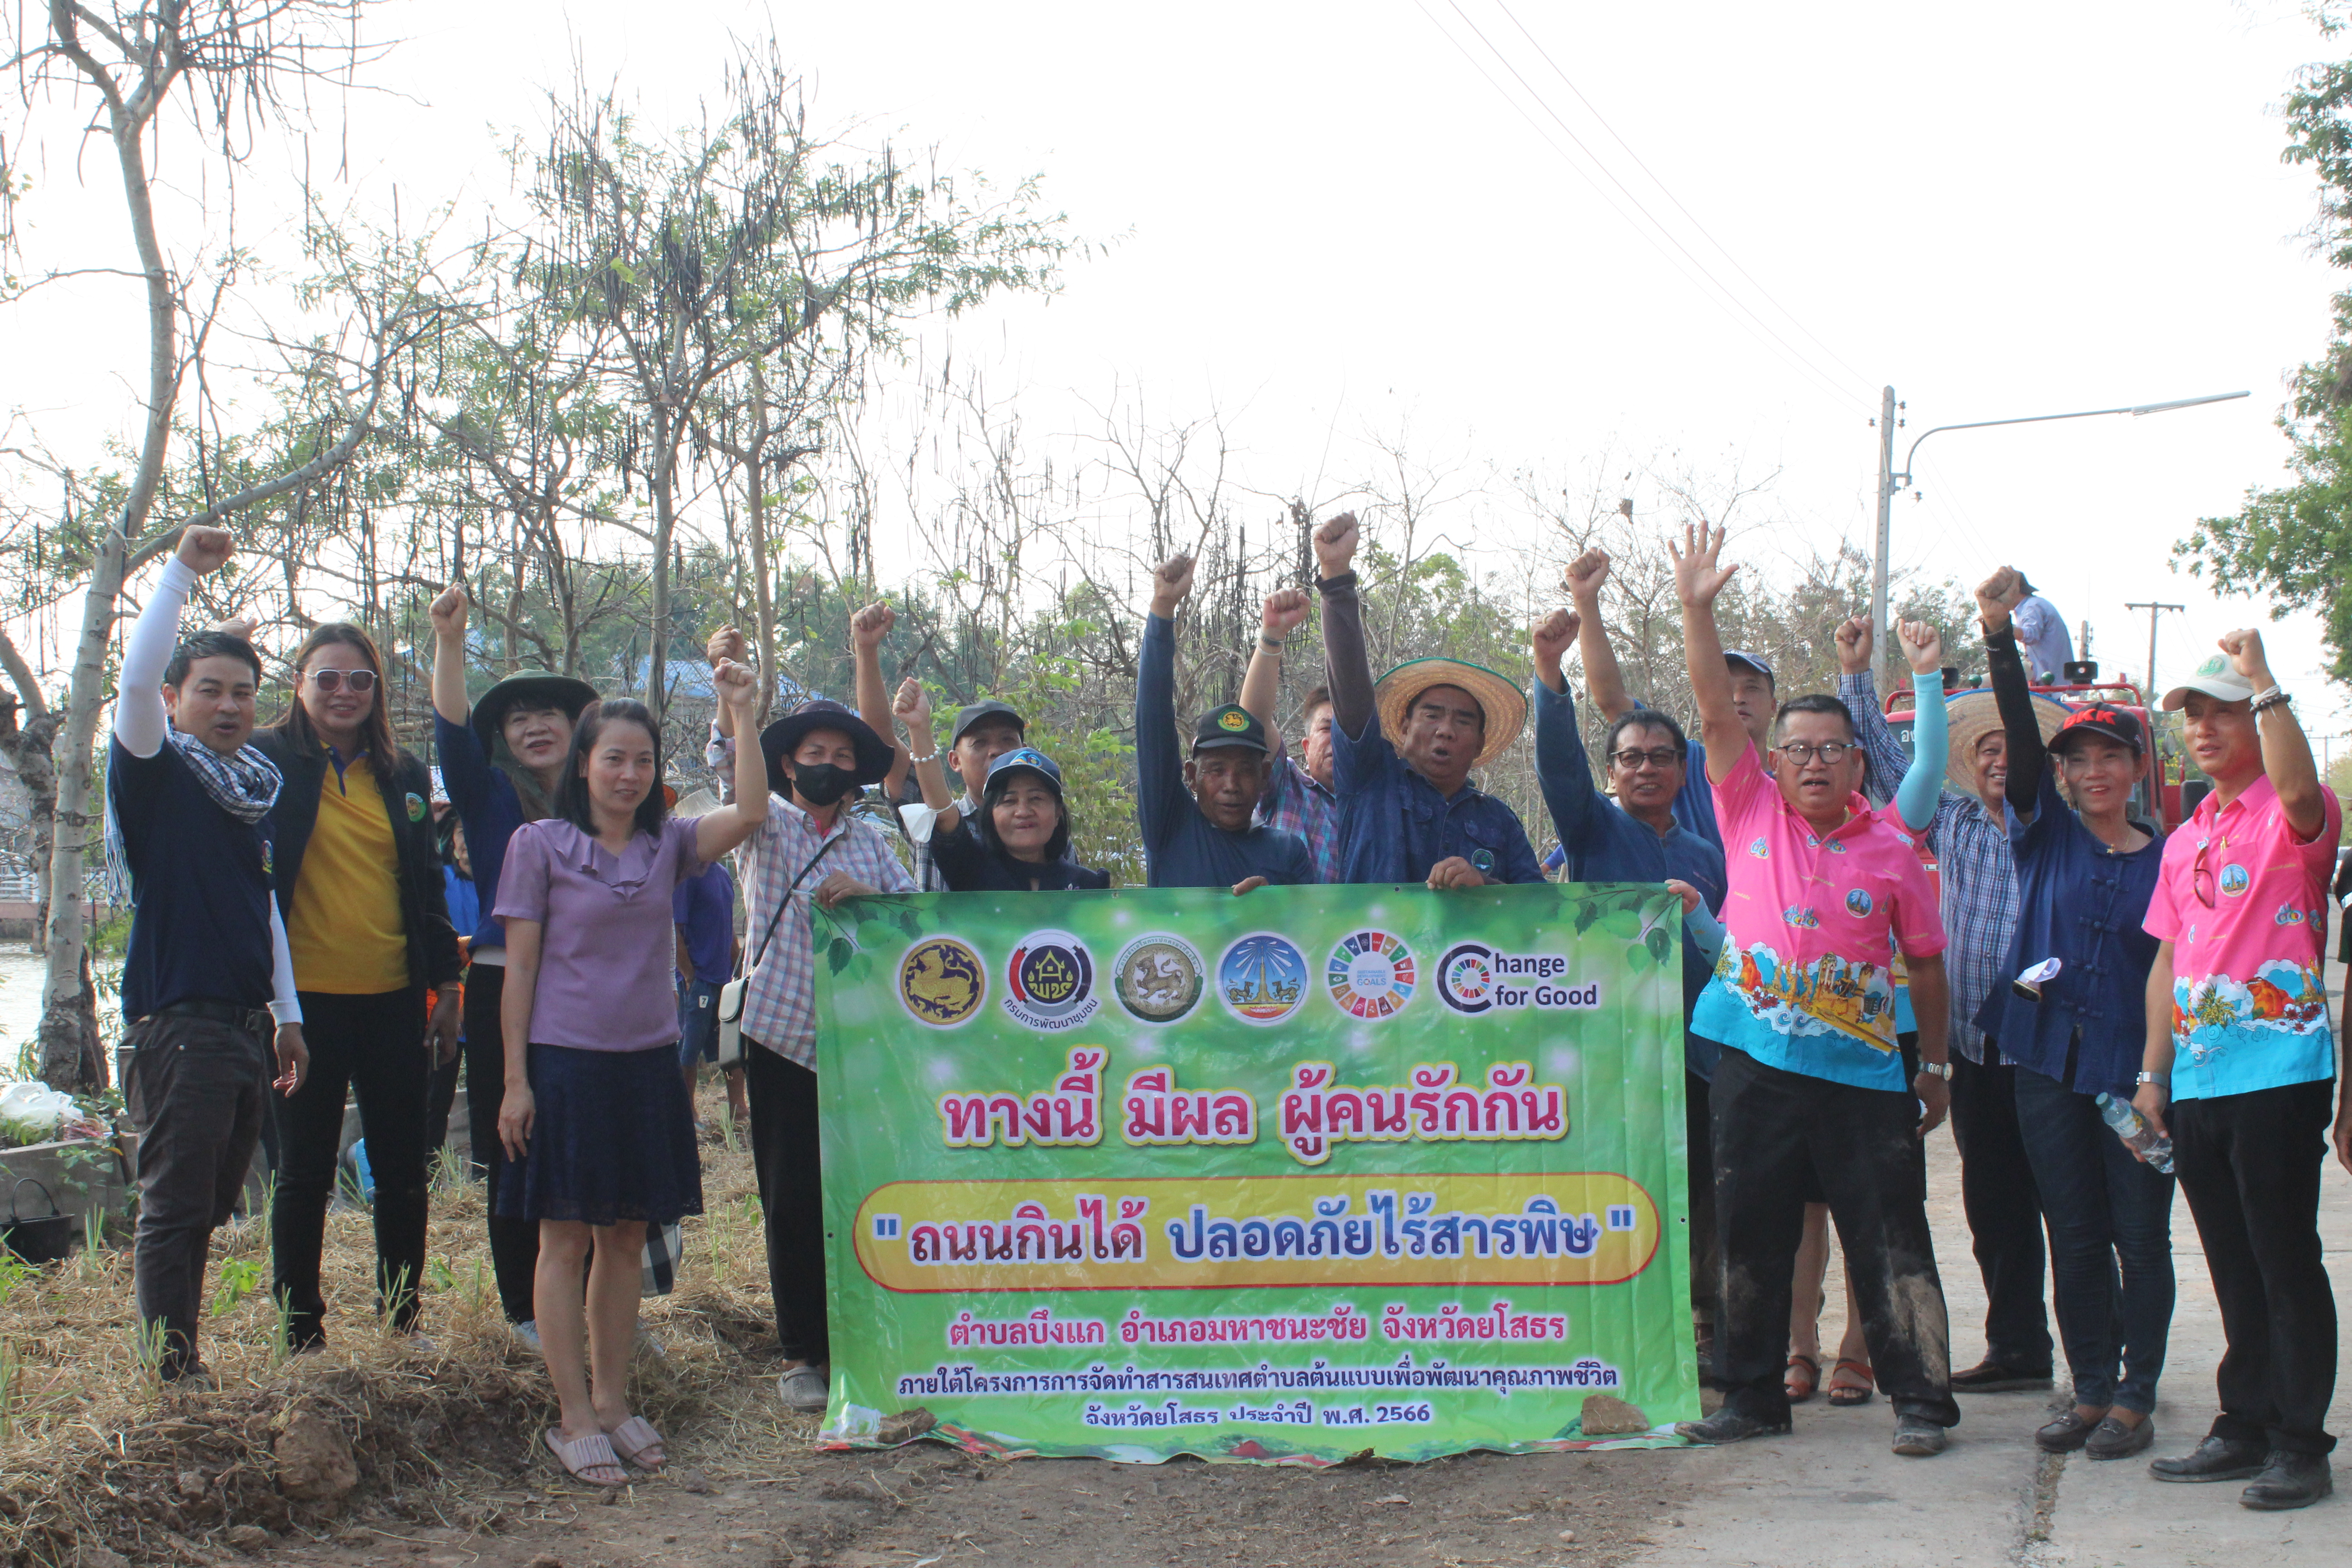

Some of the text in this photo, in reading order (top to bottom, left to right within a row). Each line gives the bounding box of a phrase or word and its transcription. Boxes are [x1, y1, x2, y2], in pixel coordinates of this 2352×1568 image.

[2063, 708, 2117, 730] BKK
[1495, 985, 1597, 1005] for Good
[1004, 999, 1098, 1029] กรมการพัฒนาชุมชน
[944, 1052, 1560, 1156] ทางนี้ มีผล ผู้คนรักกัน
[950, 1303, 1565, 1345] ตำบลบึงแก อำเภอมหาชนะชัย จังหวัดยโสธร
[899, 1354, 1617, 1395] ภายใต้โครงการการจัดทำสารสนเทศตำบลต้นแบบเพื่อพัฒนาคุณภาพชีวิต
[1086, 1401, 1430, 1426] จังหวัดยโสธร ประจำปี พ.ศ. 2566
